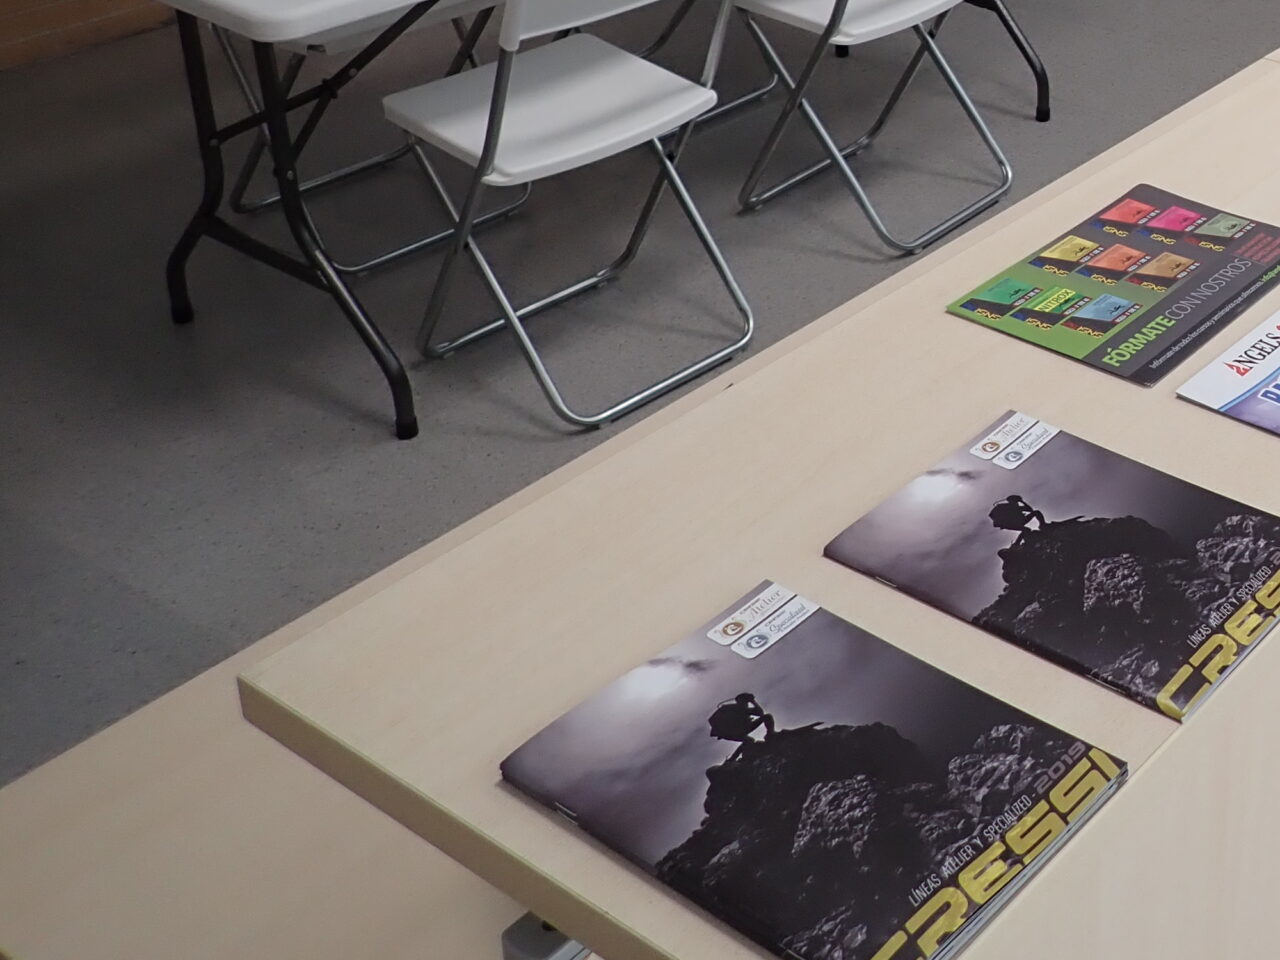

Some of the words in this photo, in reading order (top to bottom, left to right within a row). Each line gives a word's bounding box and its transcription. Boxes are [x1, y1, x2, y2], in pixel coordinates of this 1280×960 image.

[1099, 314, 1178, 367] FÓRMATE
[1160, 295, 1203, 321] CON
[1188, 256, 1254, 300] NOSTROS
[1187, 625, 1212, 648] LÍNEAS
[1209, 602, 1234, 628] ATELIER
[1236, 565, 1271, 600] SPECIALIZED
[908, 873, 942, 907] LÍNEAS
[940, 844, 976, 879] ATELIER
[983, 794, 1032, 841] SPECIALIZED
[1034, 741, 1086, 792] 2019
